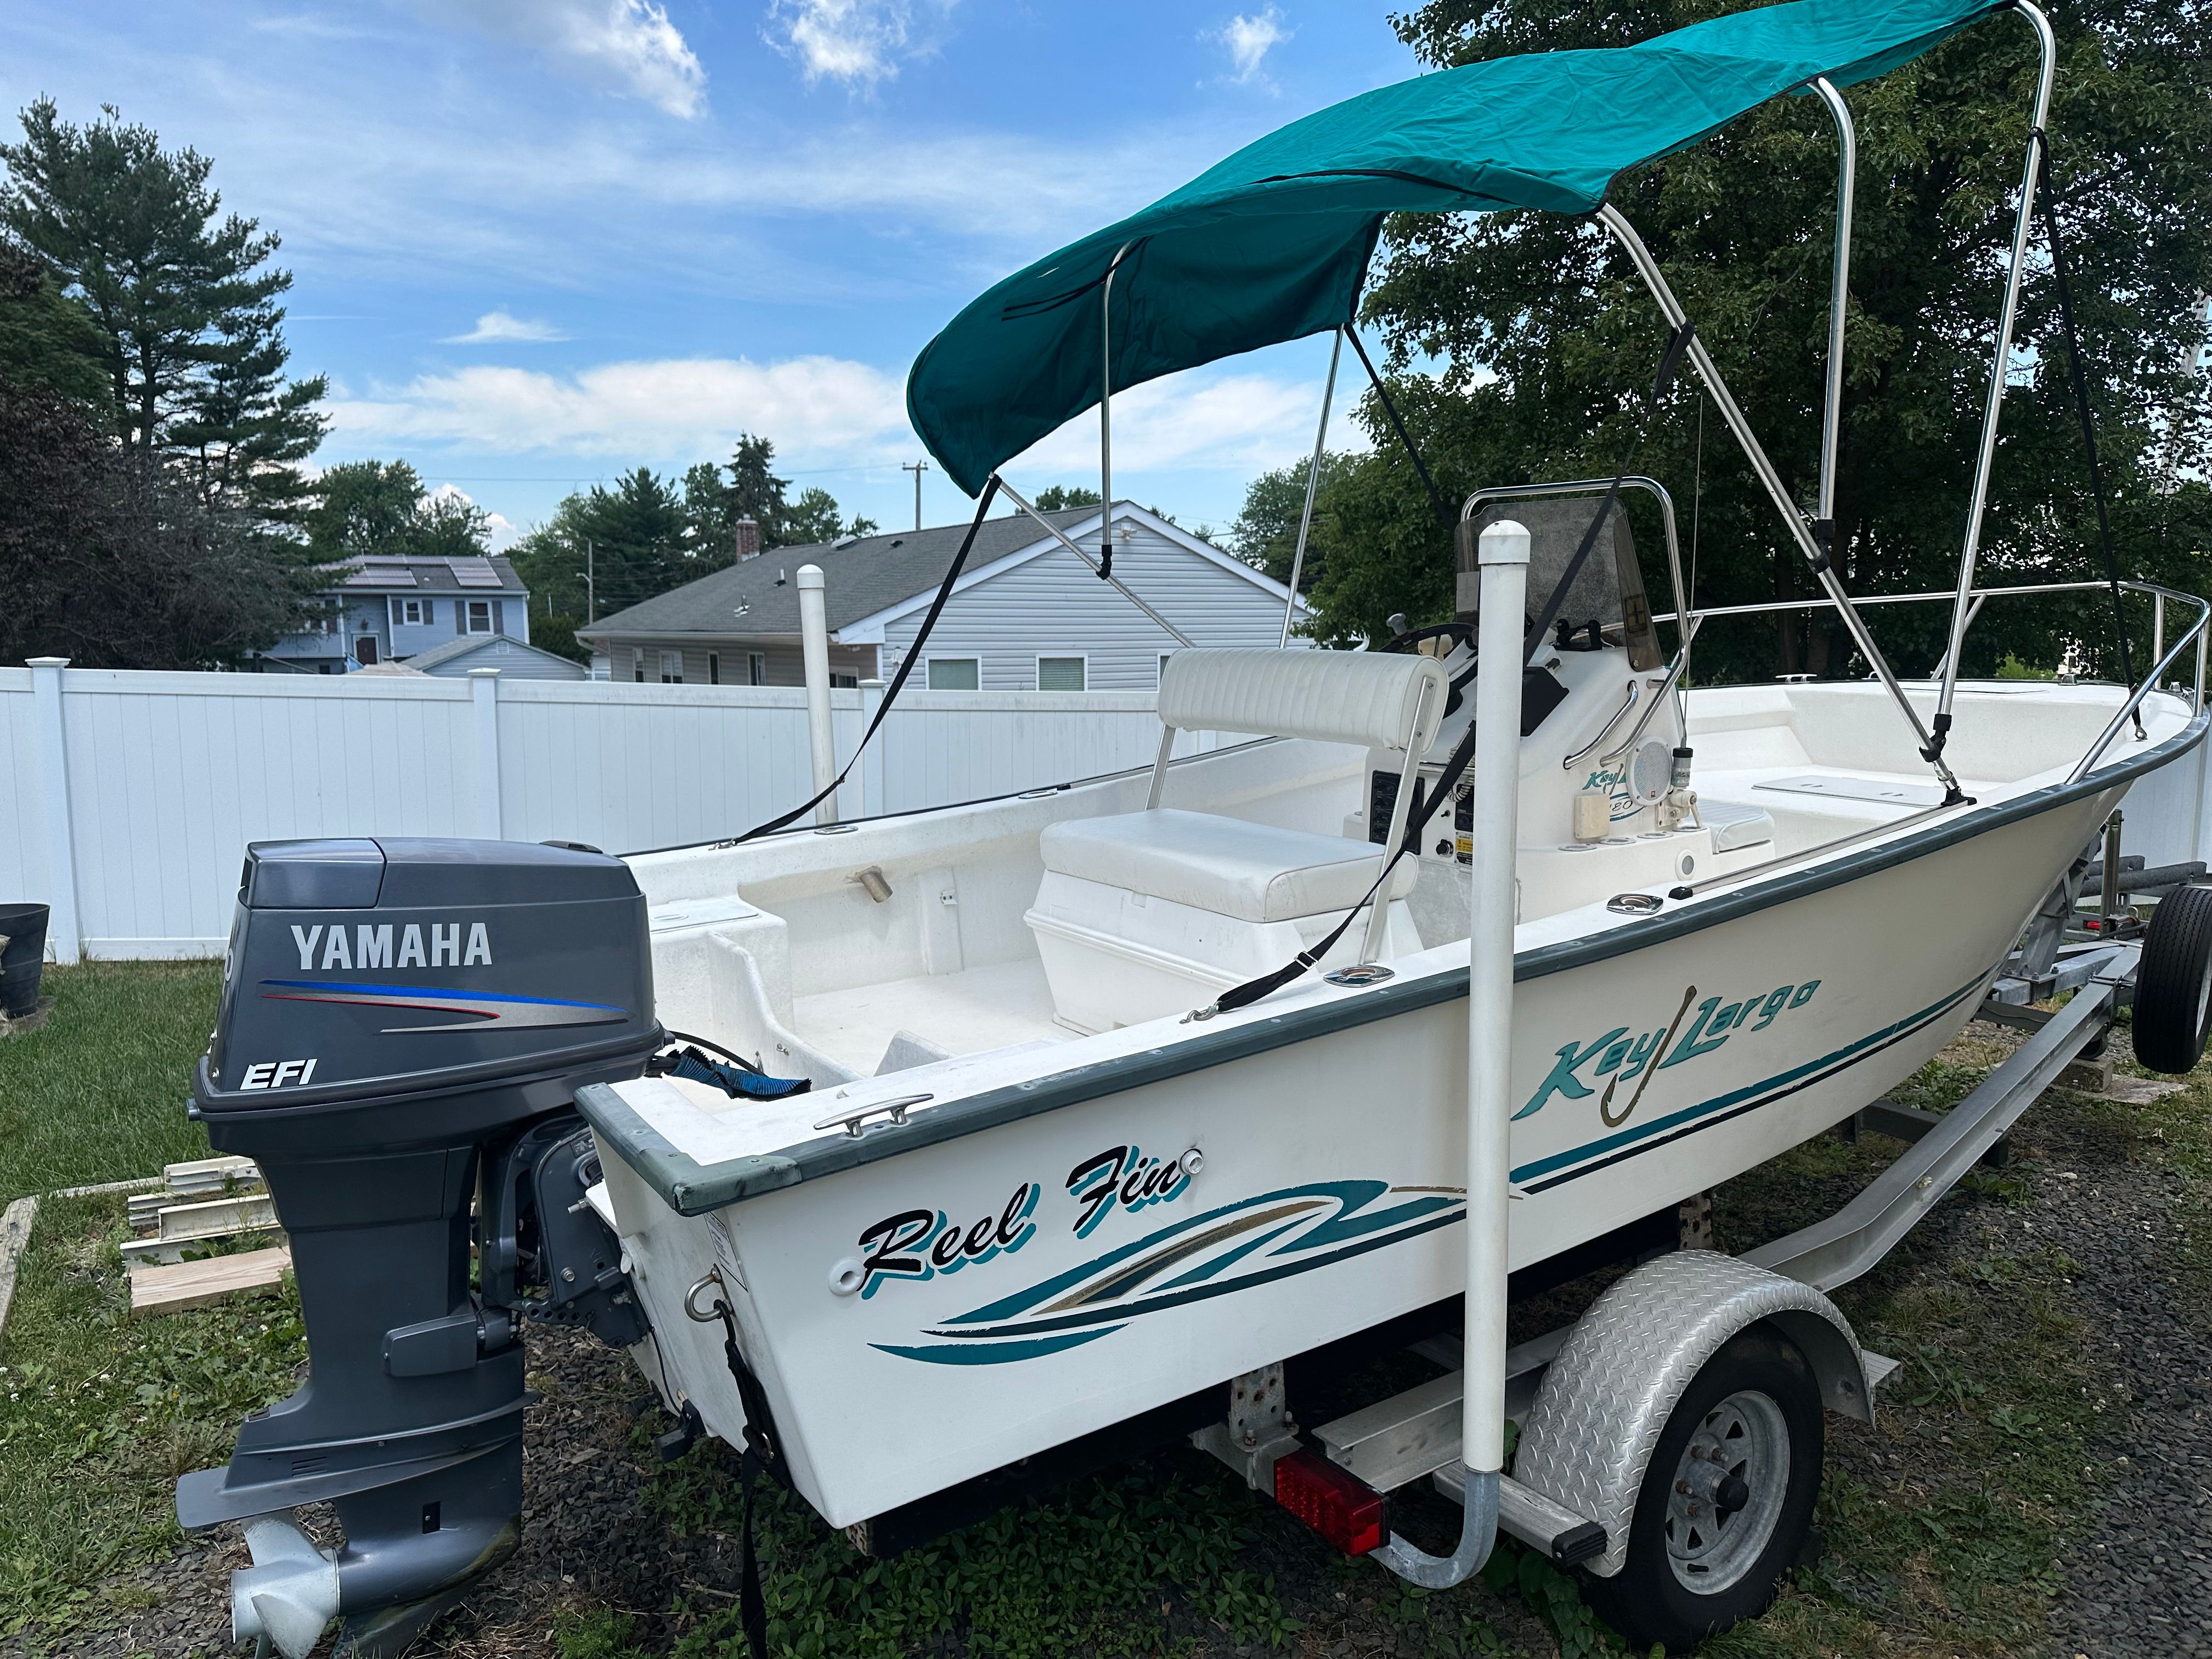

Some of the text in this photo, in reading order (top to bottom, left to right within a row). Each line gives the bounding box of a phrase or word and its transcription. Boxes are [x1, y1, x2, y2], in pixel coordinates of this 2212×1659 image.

[290, 923, 492, 970] YAMAHA
[240, 1058, 318, 1090] EFI
[1510, 980, 1821, 1121] Key Largo
[857, 1182, 1041, 1301] Reel
[1065, 1145, 1191, 1240] Fin
